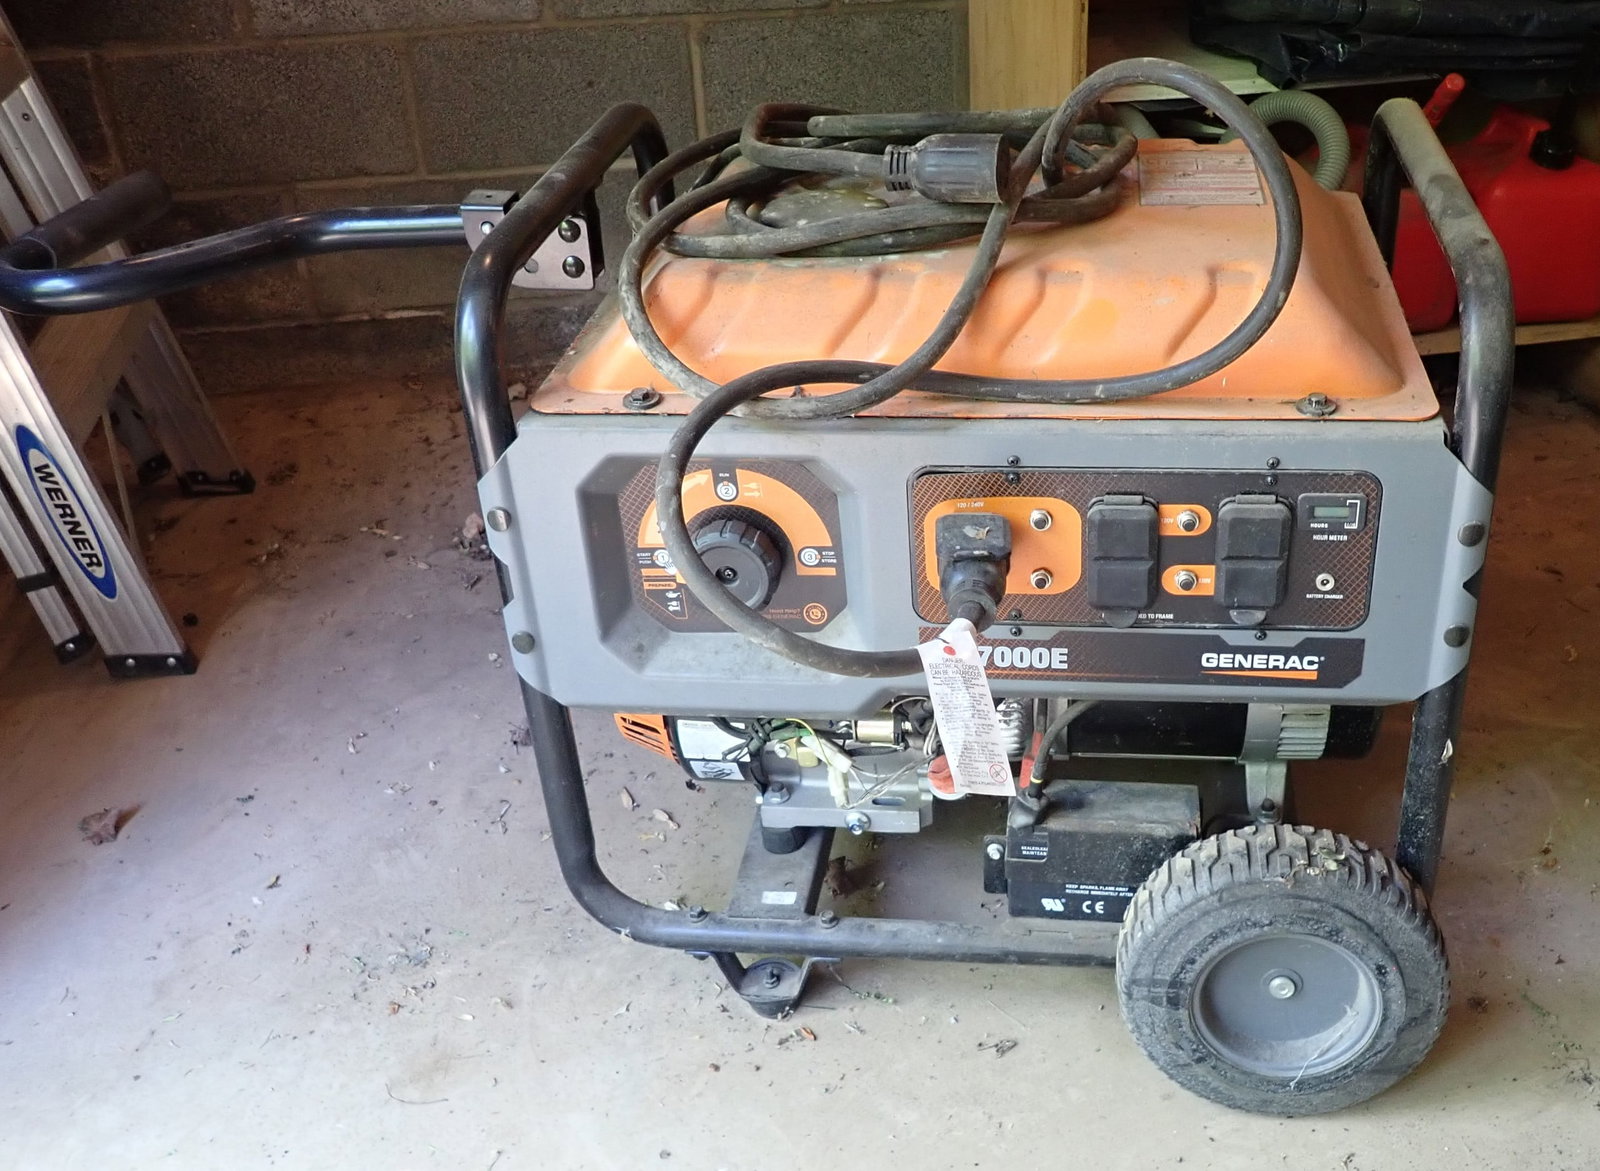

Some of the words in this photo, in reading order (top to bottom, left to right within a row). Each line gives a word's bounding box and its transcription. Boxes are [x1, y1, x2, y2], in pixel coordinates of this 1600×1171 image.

[34, 463, 103, 569] WERNER
[977, 645, 1068, 670] 7000E
[1201, 652, 1320, 670] GENERAC
[1082, 900, 1105, 914] CE
